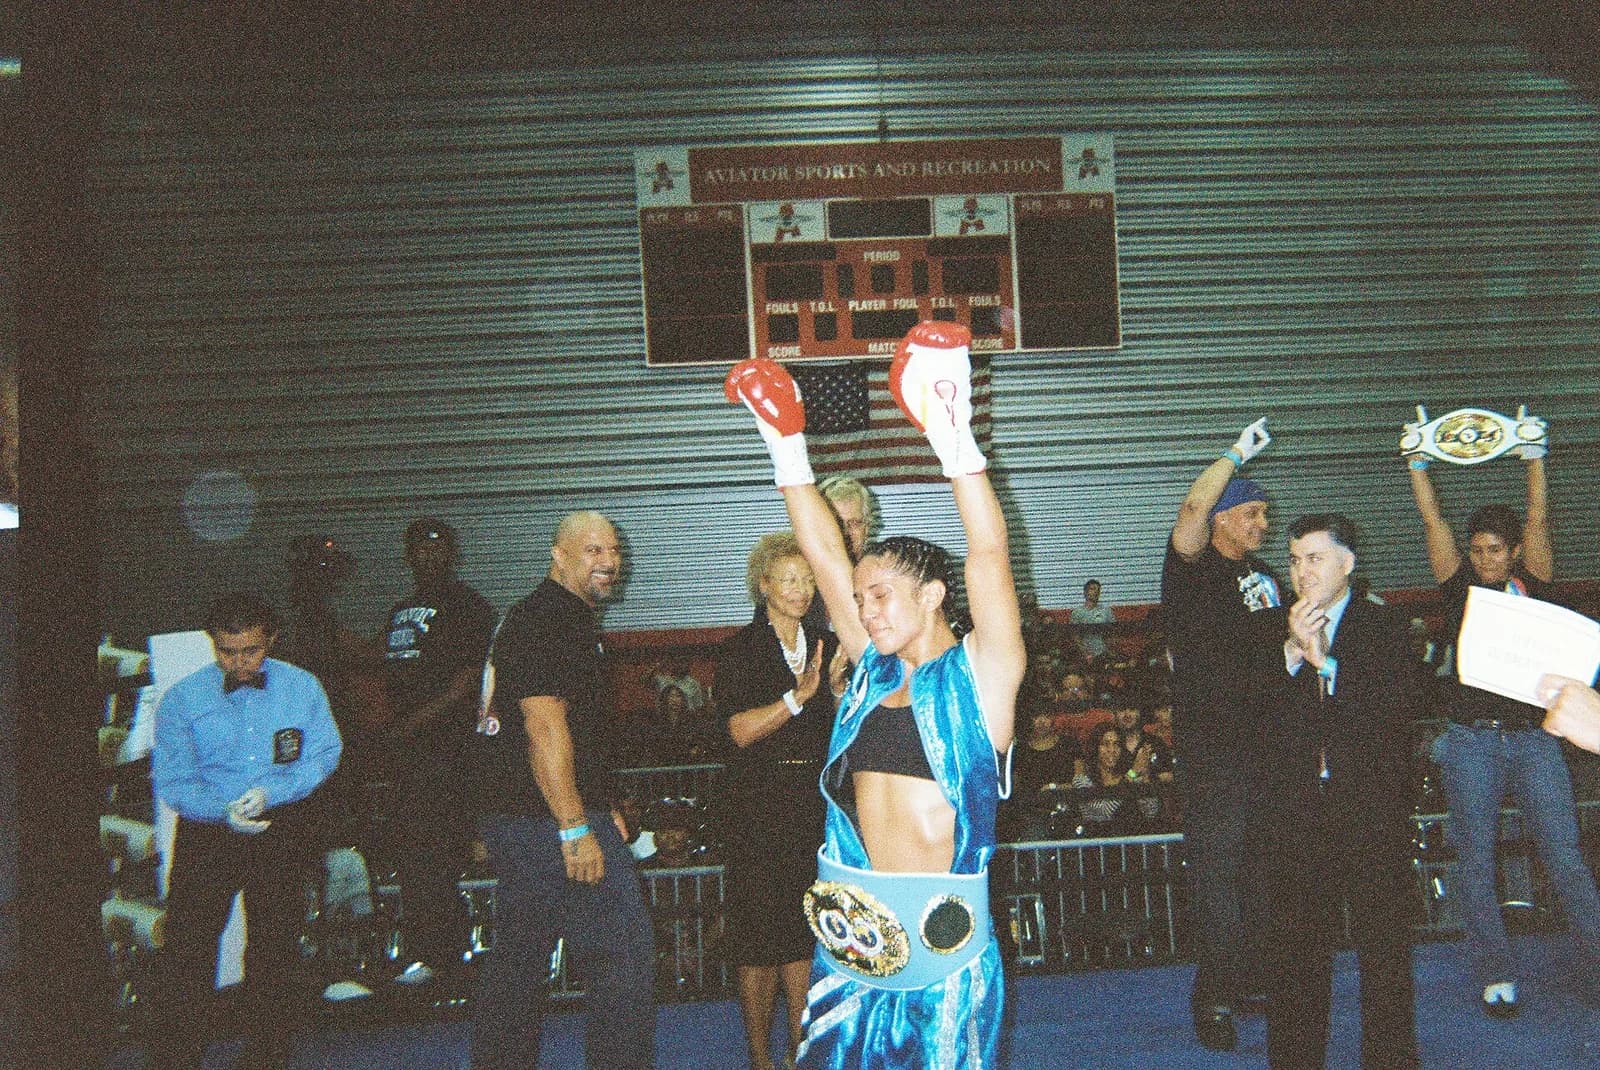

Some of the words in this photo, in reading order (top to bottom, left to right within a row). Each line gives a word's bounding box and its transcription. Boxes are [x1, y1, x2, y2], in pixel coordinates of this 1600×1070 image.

[705, 165, 789, 183] AVIATOR
[795, 162, 868, 180] SPORTS
[873, 161, 917, 177] AND
[922, 159, 1050, 176] RECREATION
[863, 250, 900, 262] PERIOD
[848, 300, 886, 312] PLAYER
[893, 298, 919, 310] FOUL
[968, 295, 1001, 307] FOULS
[765, 302, 799, 314] FOULS
[767, 346, 801, 358] SCORE
[868, 342, 897, 354] MATC
